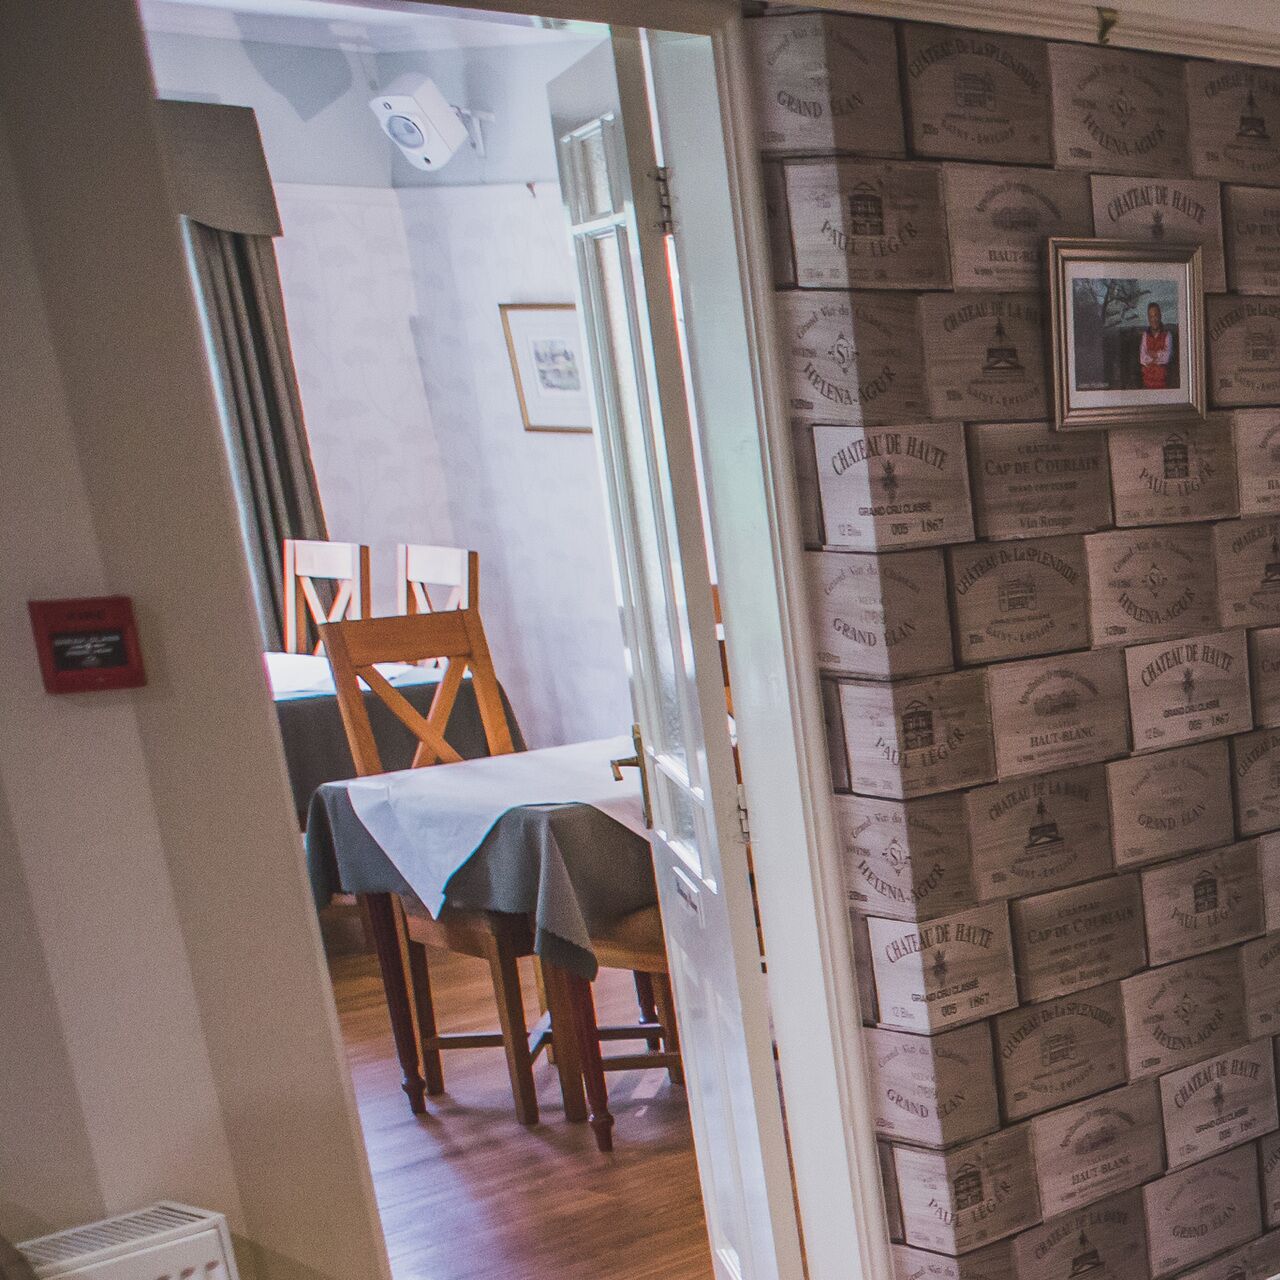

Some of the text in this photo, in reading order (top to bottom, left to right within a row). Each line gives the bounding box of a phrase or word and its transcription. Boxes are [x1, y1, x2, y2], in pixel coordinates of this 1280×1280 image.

[777, 91, 822, 118] GRAND
[820, 220, 858, 255] PAUL
[885, 433, 901, 455] DE
[906, 436, 948, 471] HAUTE
[921, 518, 944, 532] 1867
[833, 617, 877, 647] GRAND
[1186, 643, 1198, 663] DE
[1201, 645, 1235, 674] HAUTE
[1029, 725, 1098, 748] HAUT-BLANC
[874, 736, 910, 769] PAUL
[857, 860, 946, 904] HELENA-AGUR
[936, 924, 950, 944] DE
[955, 923, 994, 950] HAUTE
[886, 1088, 930, 1119] GRAND
[927, 1198, 961, 1229] PAUL
